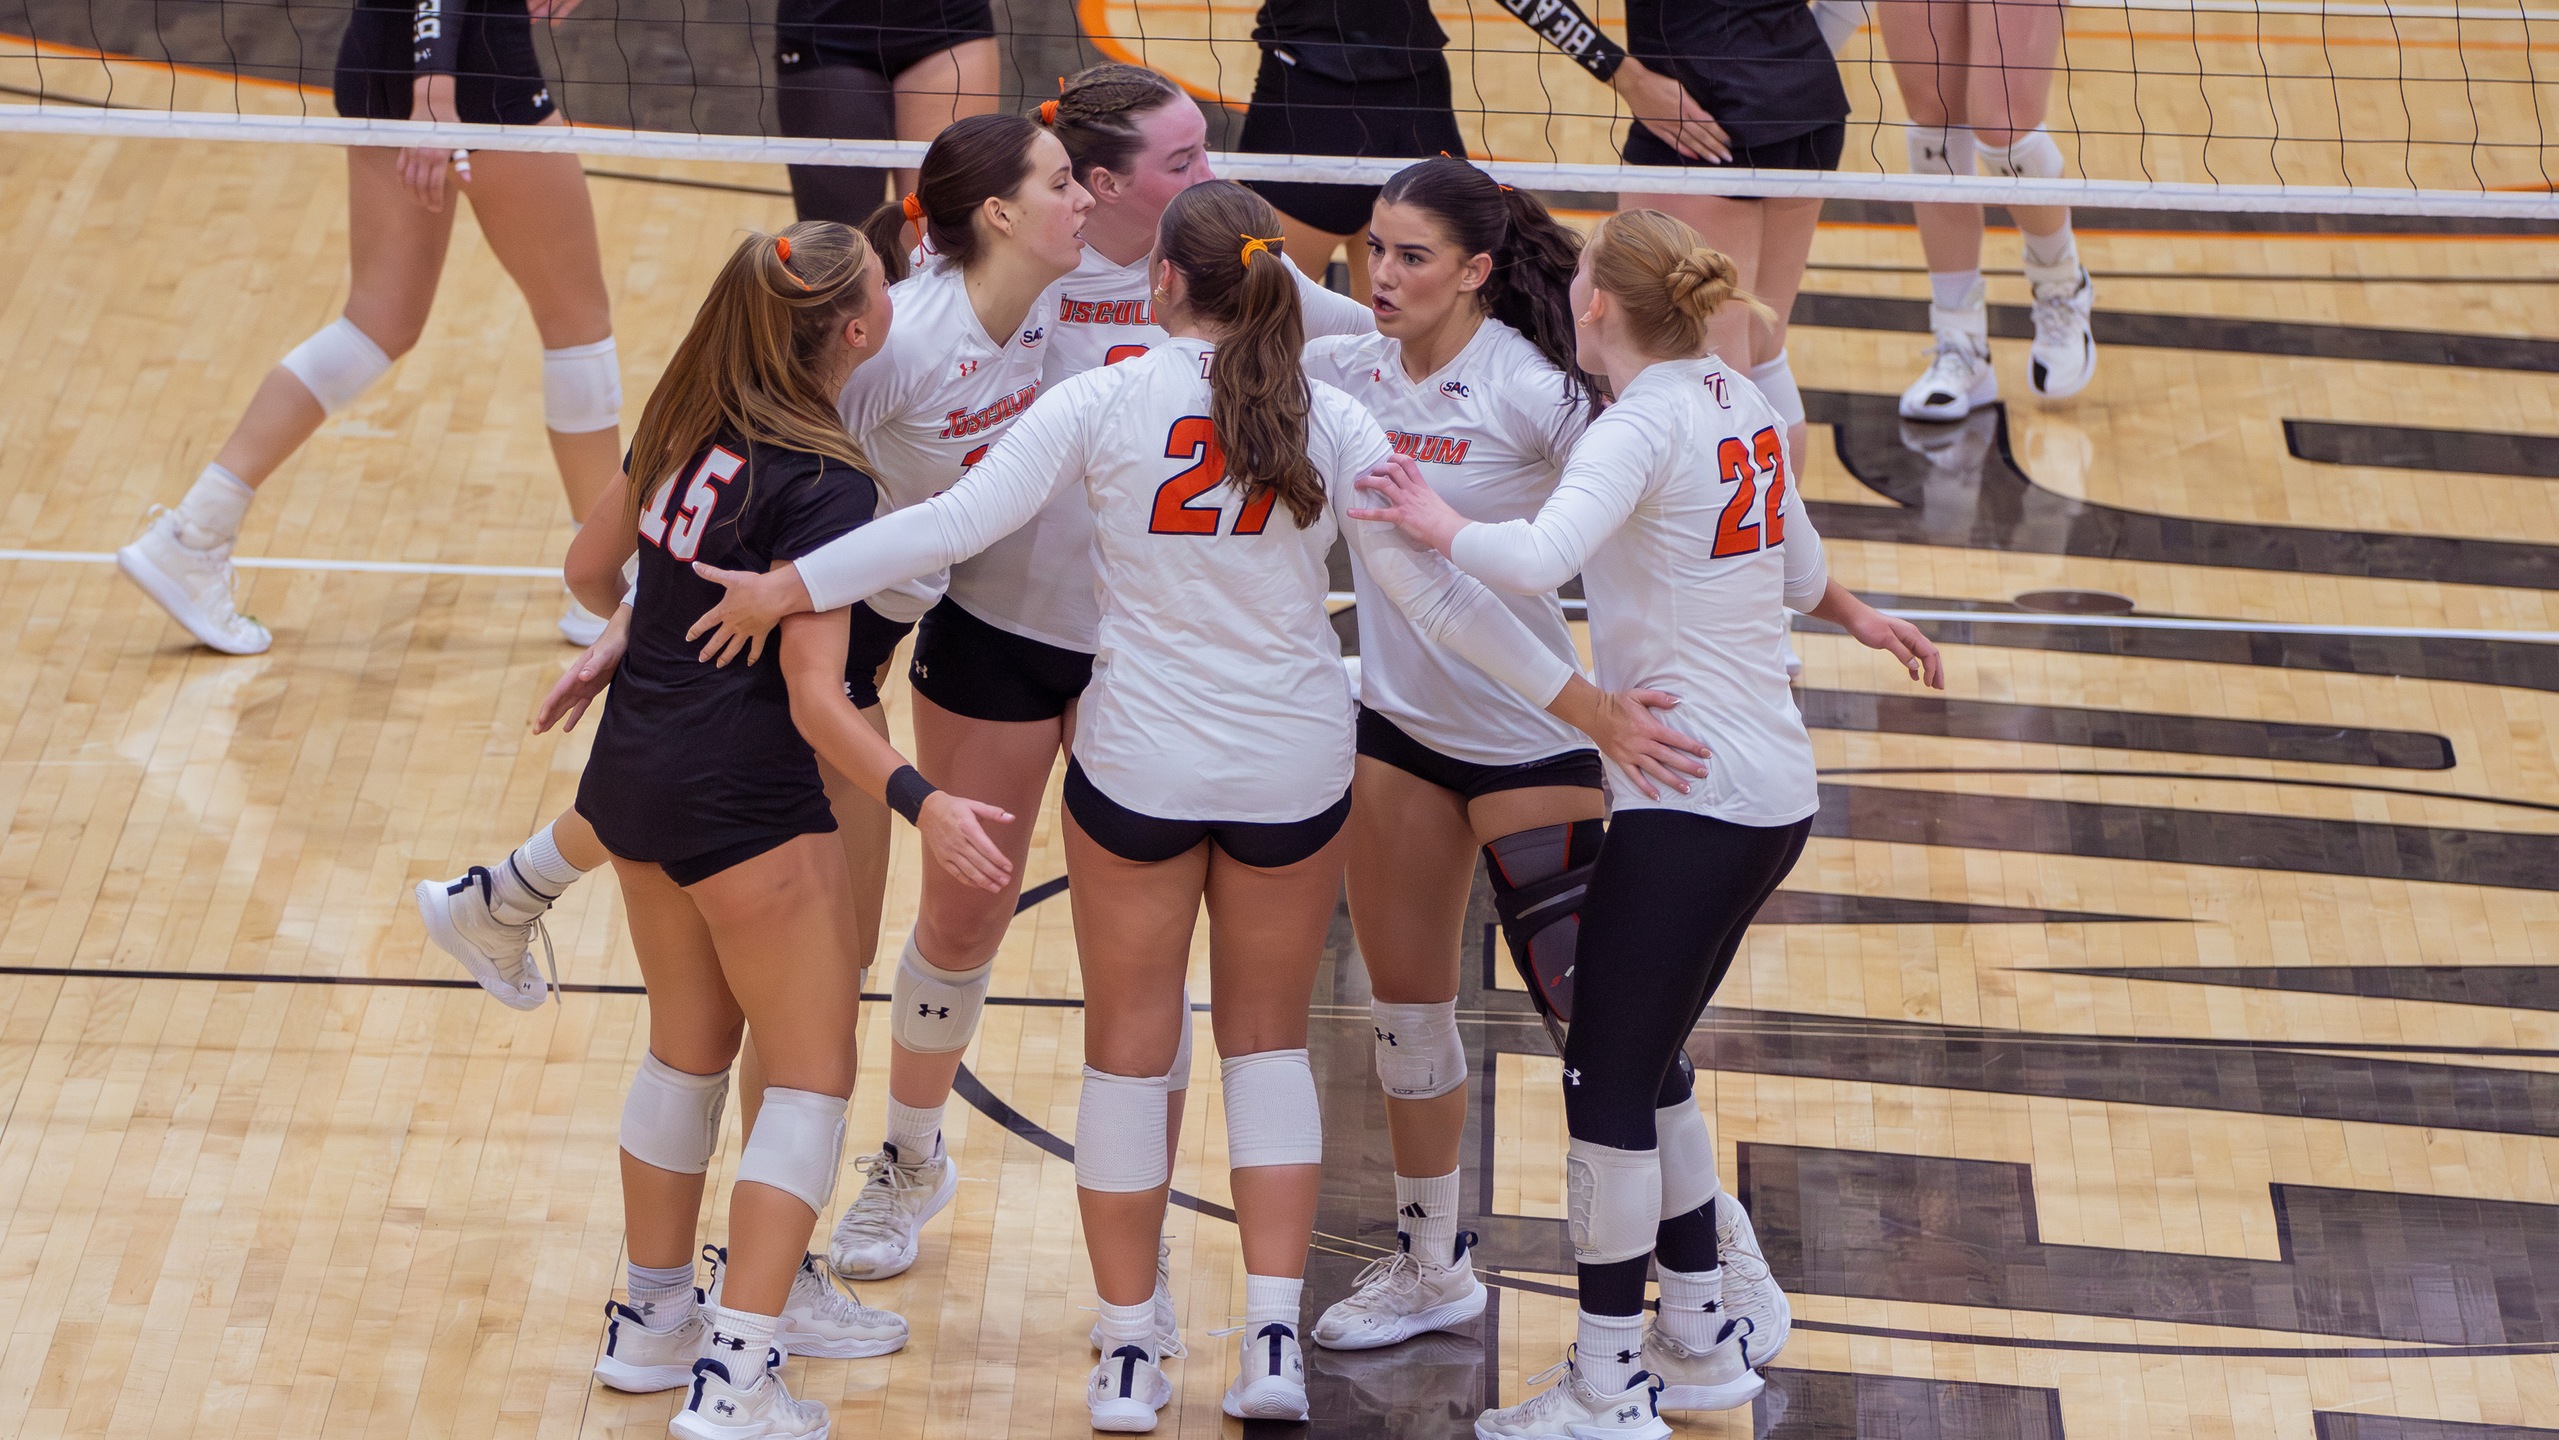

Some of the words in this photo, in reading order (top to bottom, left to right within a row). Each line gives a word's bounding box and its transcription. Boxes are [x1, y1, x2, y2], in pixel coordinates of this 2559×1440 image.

[1023, 327, 1044, 343] SAC
[1199, 351, 1217, 380] T
[1443, 382, 1470, 398] SAC
[638, 444, 747, 562] 15
[1710, 425, 1785, 560] 22
